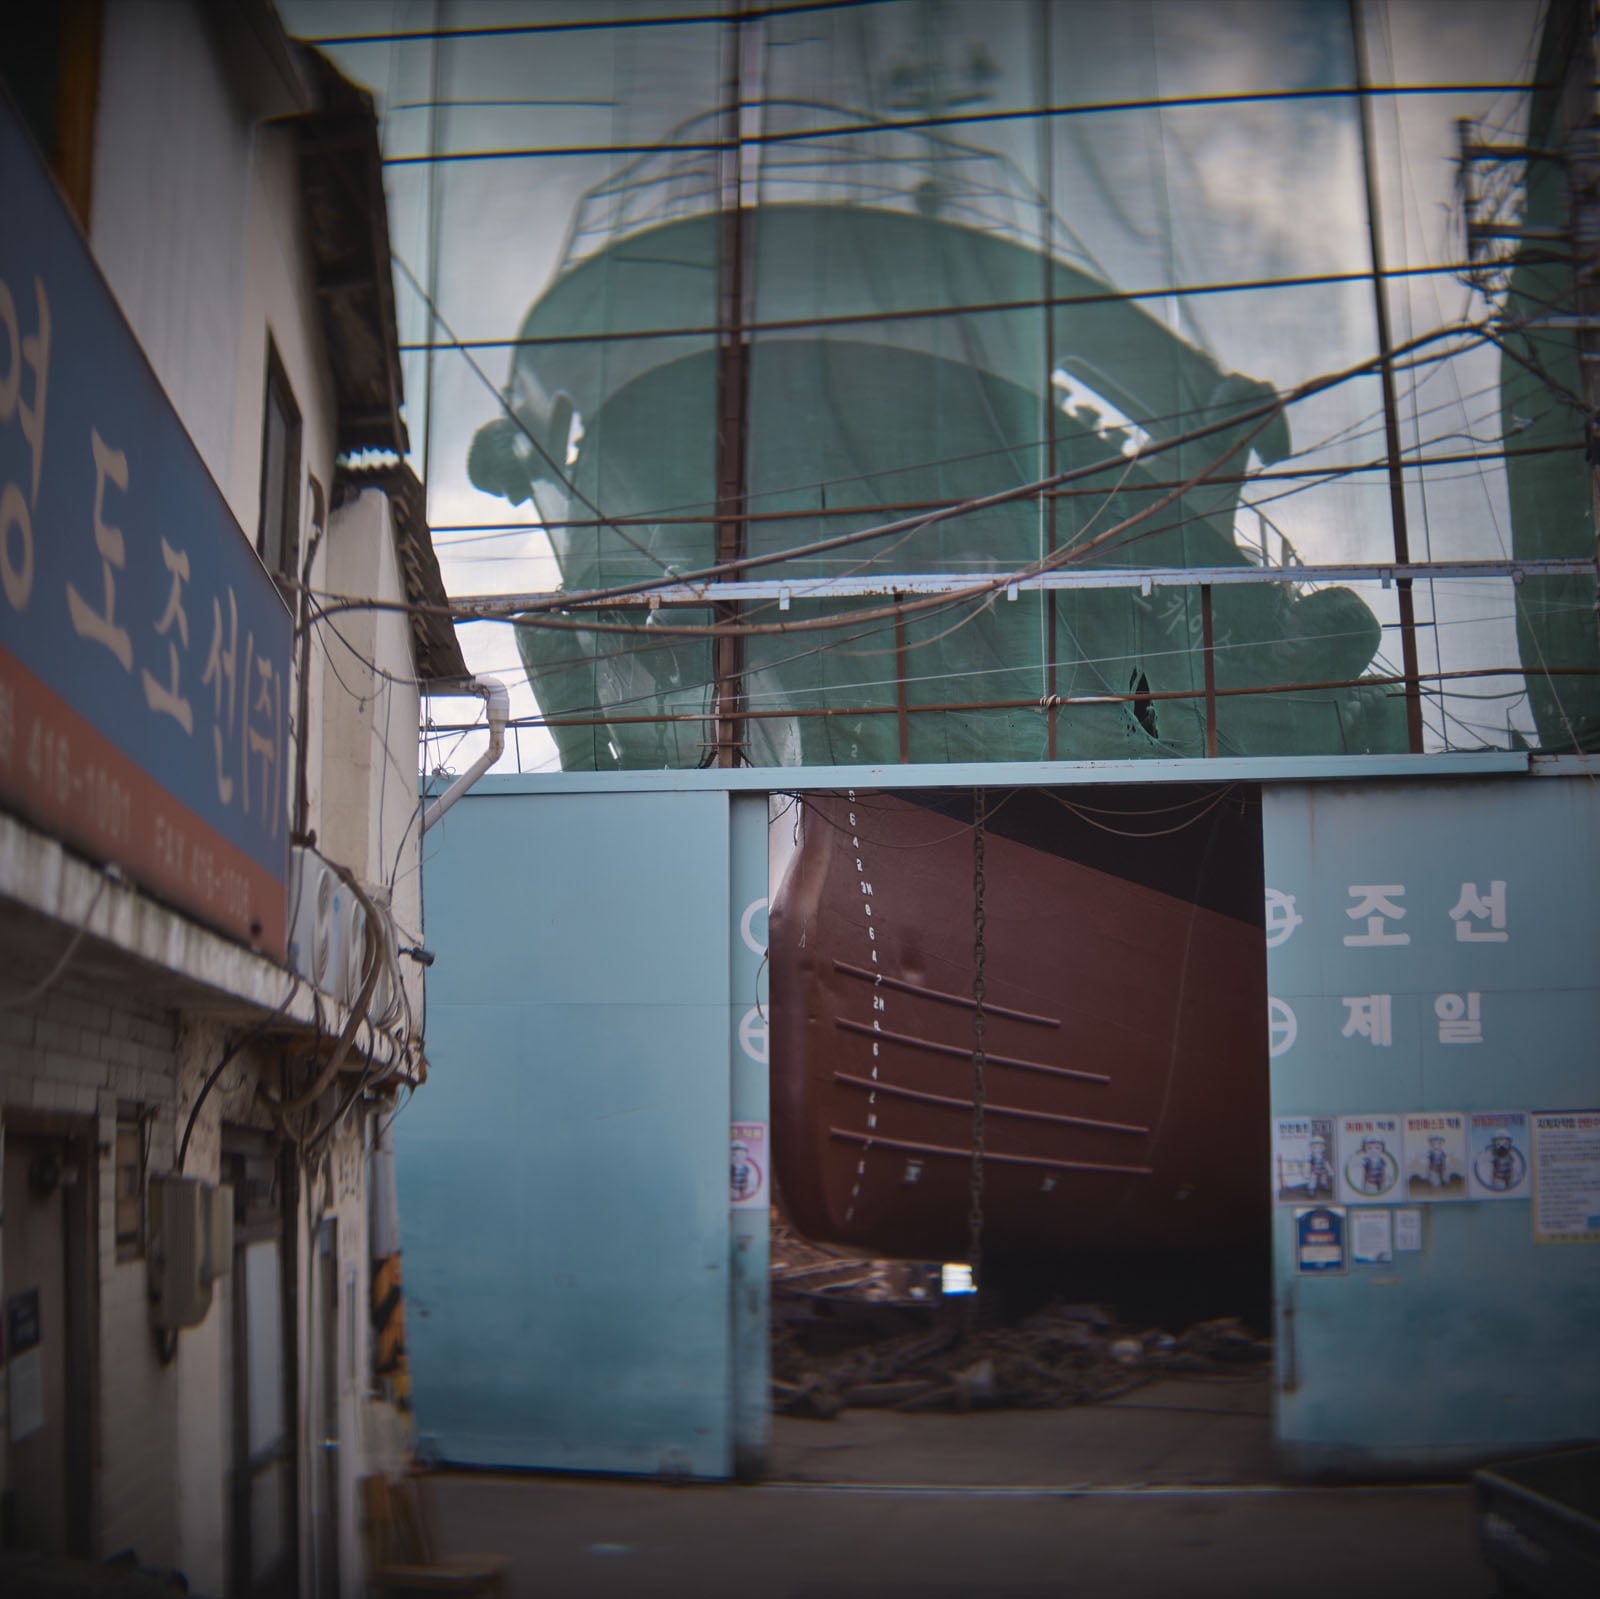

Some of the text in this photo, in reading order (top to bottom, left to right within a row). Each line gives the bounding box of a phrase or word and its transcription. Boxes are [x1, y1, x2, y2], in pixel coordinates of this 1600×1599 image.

[850, 743, 858, 758] 2
[849, 812, 856, 826] 6
[852, 836, 859, 848] 4
[856, 858, 863, 871] 2
[869, 927, 876, 940] 6
[872, 950, 878, 963] 4
[874, 974, 883, 986] 2
